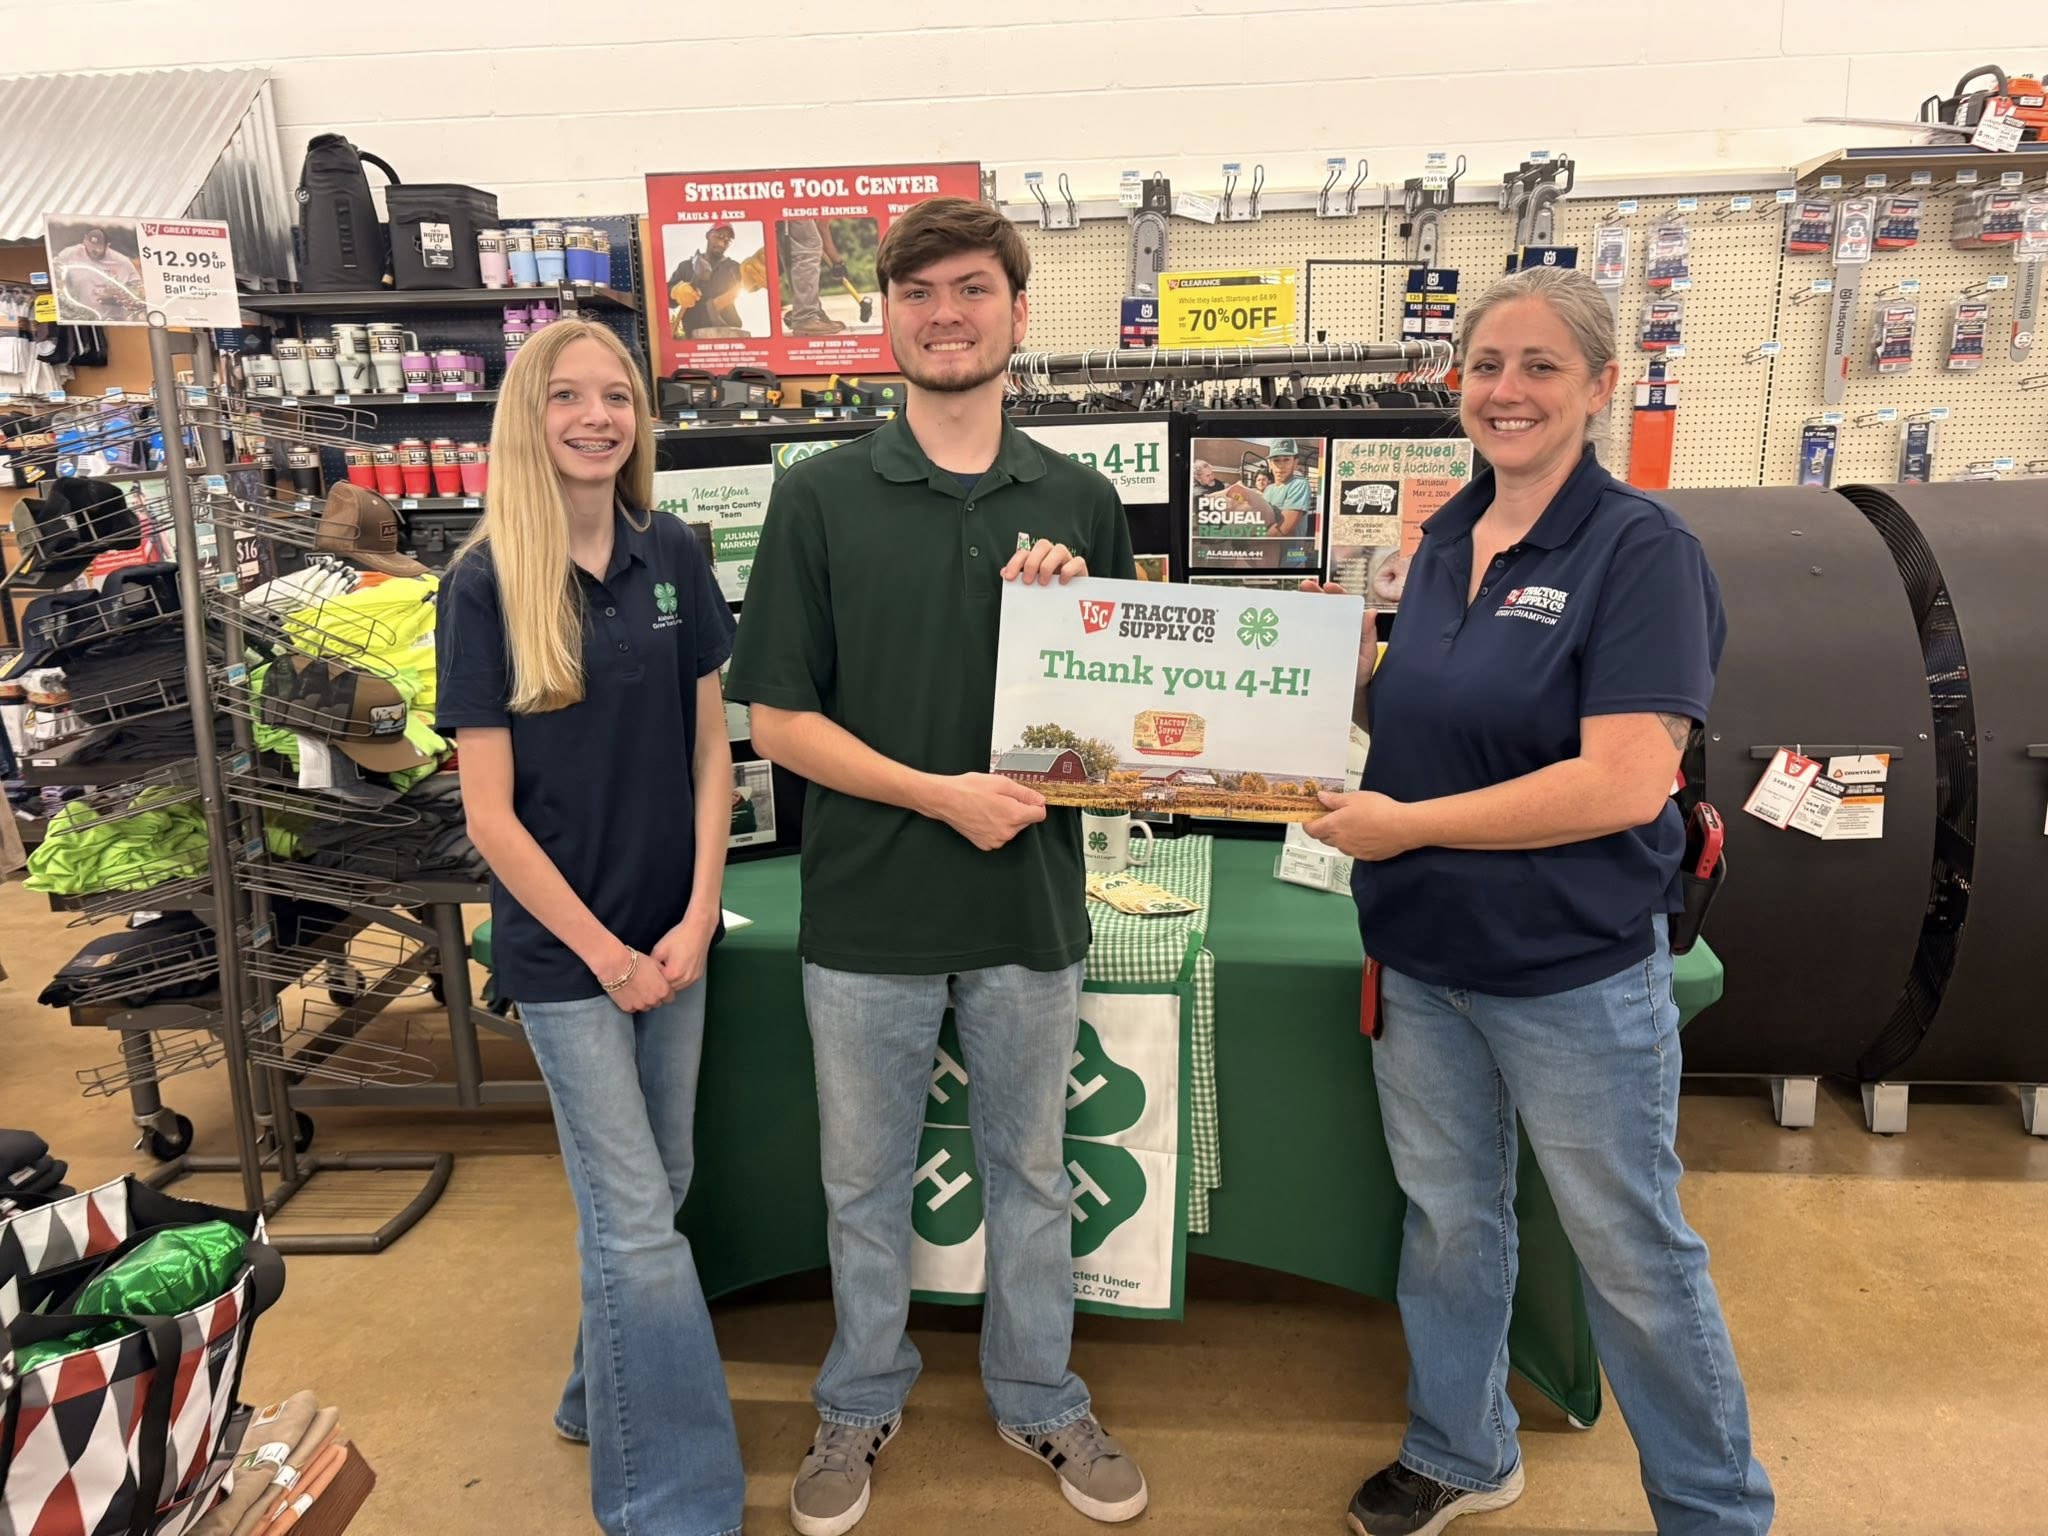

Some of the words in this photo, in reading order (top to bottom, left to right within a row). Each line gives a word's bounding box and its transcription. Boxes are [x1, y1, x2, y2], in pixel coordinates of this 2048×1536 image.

[685, 181, 785, 202] STRIKING
[790, 178, 849, 197] TOOL
[855, 175, 939, 195] CENTER
[677, 211, 709, 222] MAULS
[711, 211, 718, 220] &
[721, 210, 745, 220] AXES
[782, 207, 819, 217] SLEDGE
[821, 206, 868, 216] HAMMERS
[163, 226, 190, 235] GREAT
[192, 228, 220, 236] PRICE!
[142, 246, 211, 268] $12.99
[212, 261, 226, 269] UP
[163, 272, 211, 284] Branded
[1181, 279, 1221, 287] CLEARANCE
[164, 285, 186, 294] Ball
[1197, 297, 1210, 305] they
[1226, 295, 1251, 303] Starting
[1834, 300, 1850, 356] Husqvarna
[380, 337, 399, 345] YETI
[505, 333, 525, 341] YETI
[1103, 442, 1160, 473] 4-H
[1351, 444, 1376, 455] 4-H
[1379, 444, 1402, 460] Pig
[1406, 444, 1456, 460] Squeal
[1359, 463, 1390, 473] Show
[1393, 463, 1401, 473] &
[1404, 462, 1445, 473] Auction
[1120, 476, 1156, 487] System
[1416, 479, 1448, 487] SATURDAY
[691, 487, 720, 501] Meet
[720, 486, 750, 501] Your
[697, 504, 730, 512] Morgan
[732, 501, 762, 510] County
[1198, 497, 1227, 511] PIG
[1198, 511, 1265, 525] SQUEAL
[724, 531, 760, 541] JULIANA
[1200, 525, 1252, 537] READY
[236, 539, 258, 562] $16
[1081, 601, 1109, 629] TSC
[1120, 602, 1216, 625] TRACTOR
[1514, 609, 1559, 626] CHAMPION
[1118, 621, 1190, 642] SUPPLY
[1039, 649, 1153, 685] Thank
[1162, 666, 1226, 695] you
[1235, 666, 1311, 698] 4-H!
[1156, 717, 1186, 727] TRACTOR
[1158, 726, 1182, 735] SUPPLY
[1103, 1275, 1141, 1290] Under
[1098, 1287, 1120, 1300] 707
